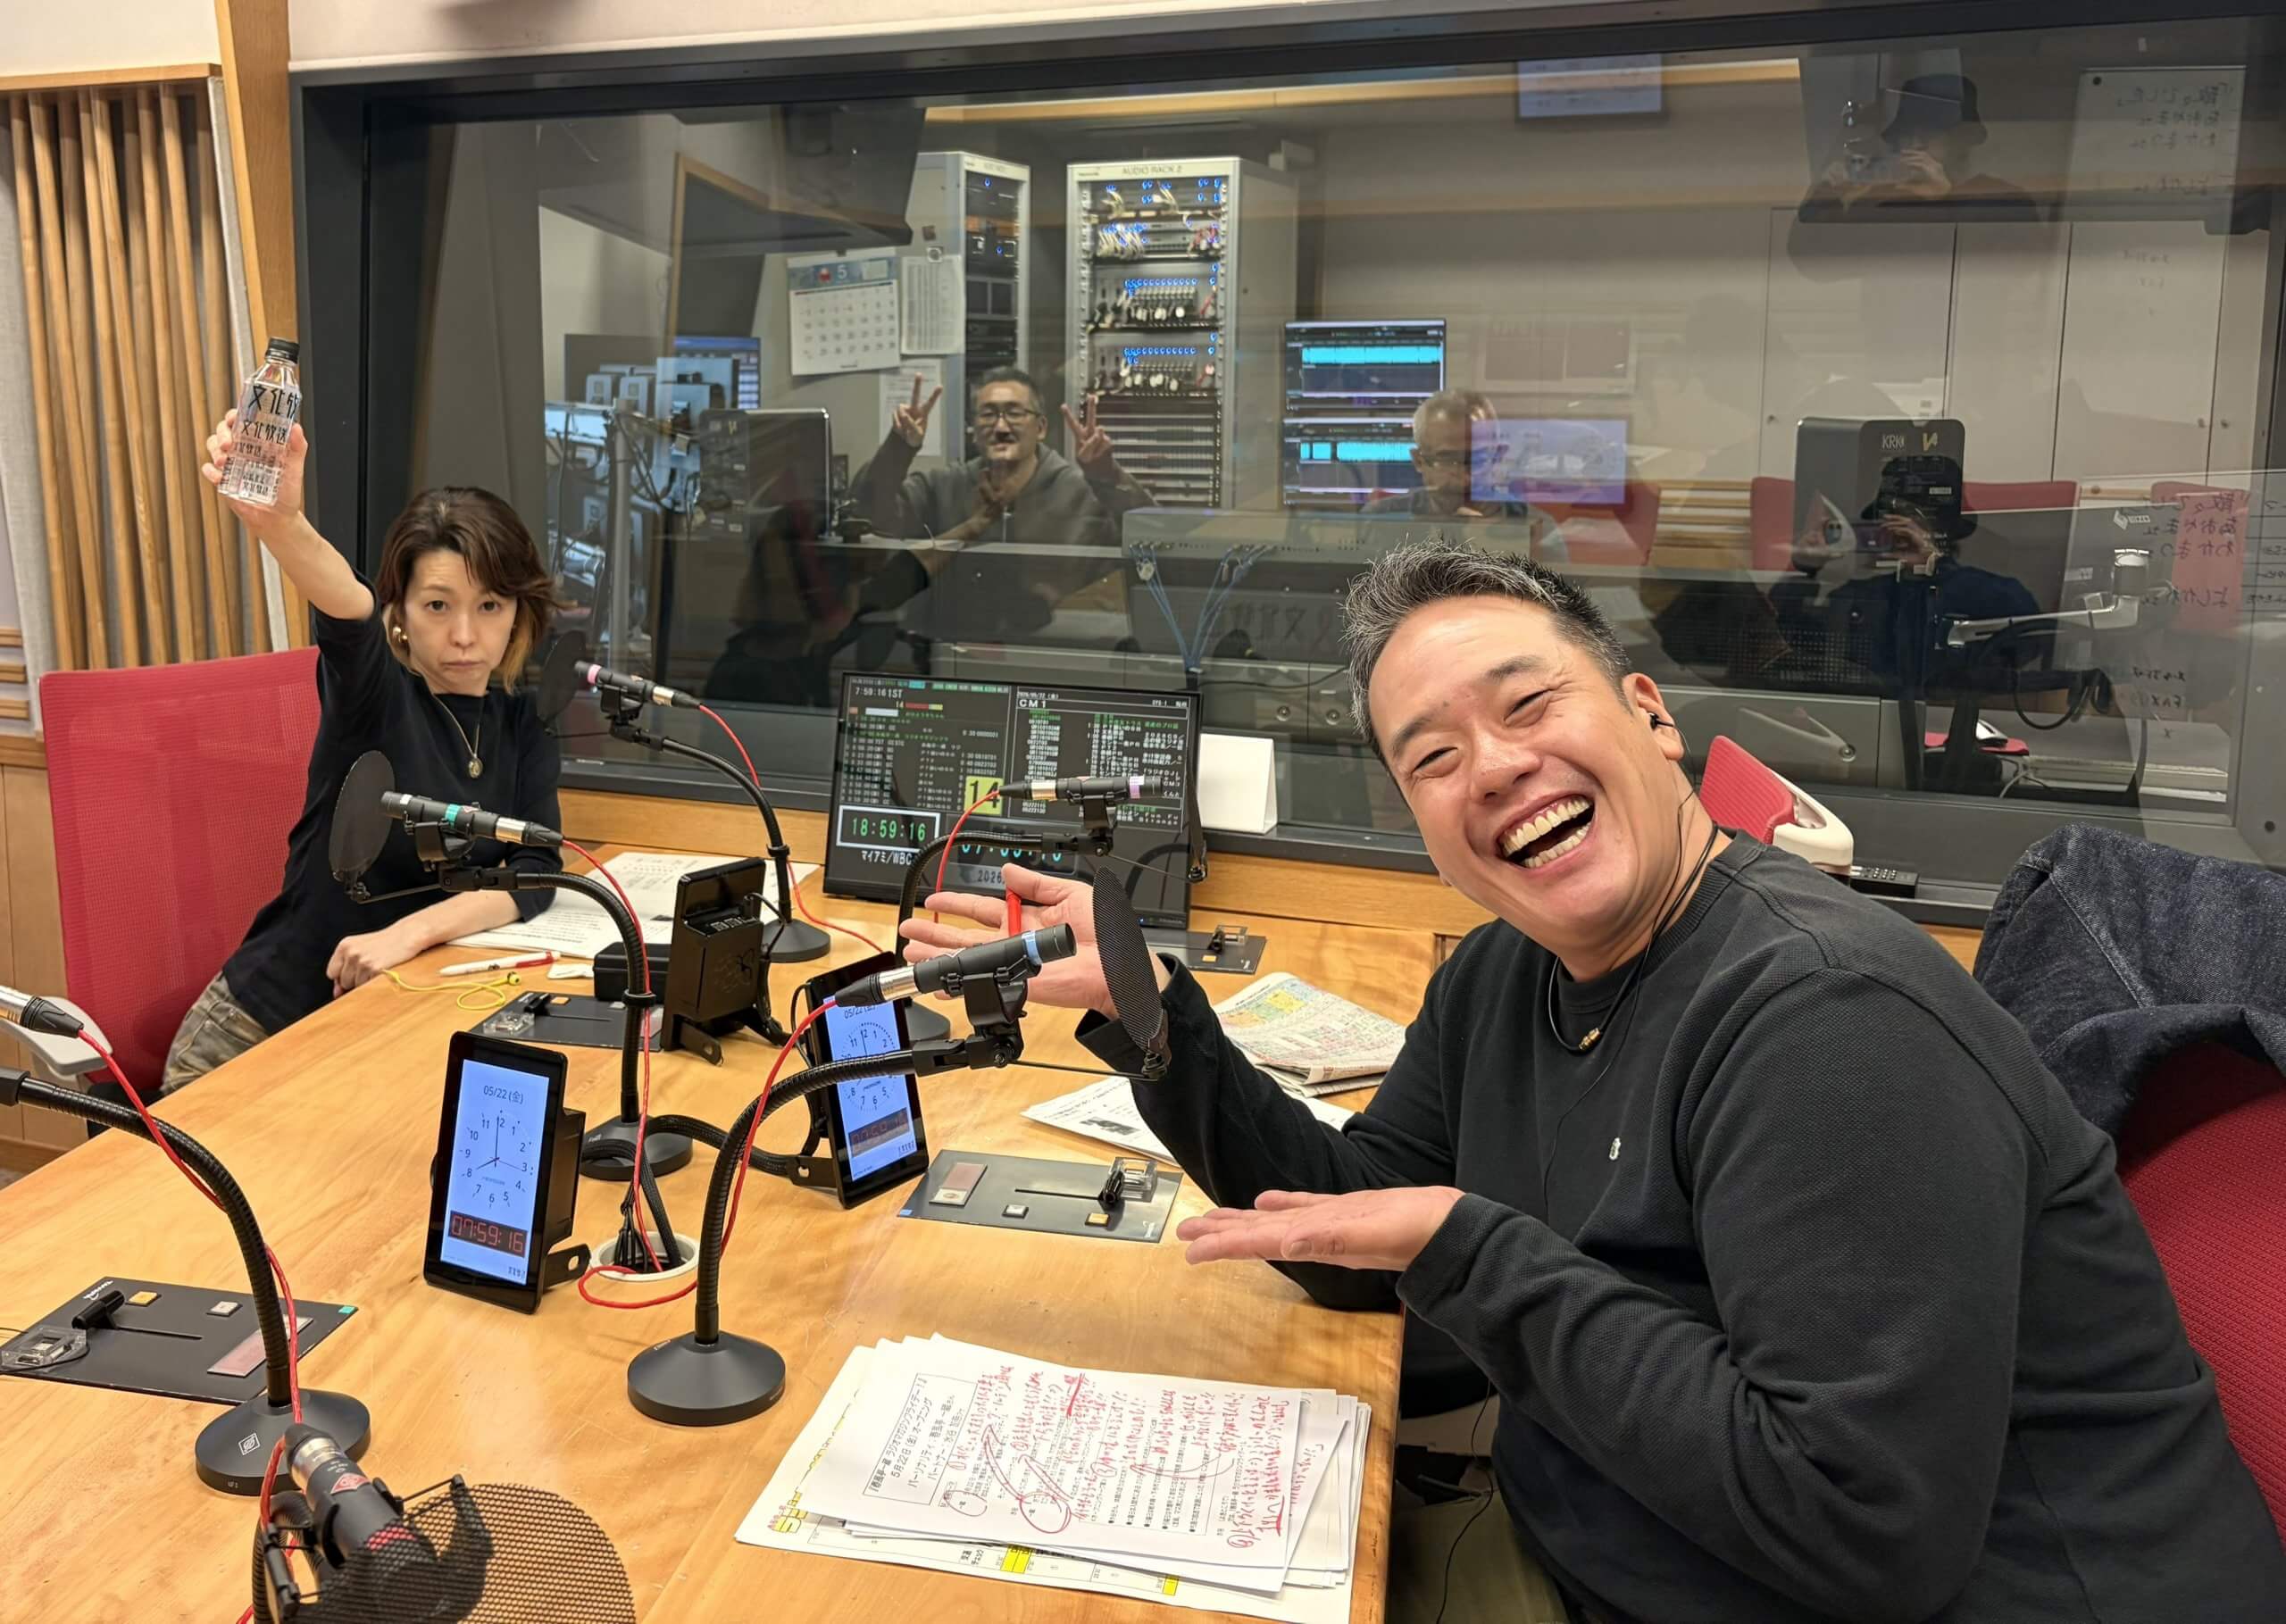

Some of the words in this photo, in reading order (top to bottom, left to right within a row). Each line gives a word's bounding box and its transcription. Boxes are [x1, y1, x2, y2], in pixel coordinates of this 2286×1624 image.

[837, 264, 847, 279] 5
[241, 420, 288, 446] 文化放送
[969, 779, 1001, 809] 14
[852, 816, 926, 842] 18:59:16
[850, 1038, 857, 1047] 11
[882, 1038, 888, 1048] 2
[483, 1085, 523, 1105] 05/22(金)
[882, 1087, 887, 1096] 5
[861, 1096, 865, 1106] 7
[872, 1095, 878, 1105] 6
[482, 1120, 490, 1129] 11
[470, 1130, 479, 1141] 10
[520, 1143, 526, 1153] 2
[465, 1149, 471, 1158] 9
[521, 1162, 528, 1172] 3
[466, 1168, 472, 1178] 8
[476, 1184, 481, 1194] 7
[515, 1180, 521, 1190] 4
[489, 1193, 495, 1203] 6
[504, 1191, 509, 1202] 5
[451, 1214, 524, 1253] 07:59:16
